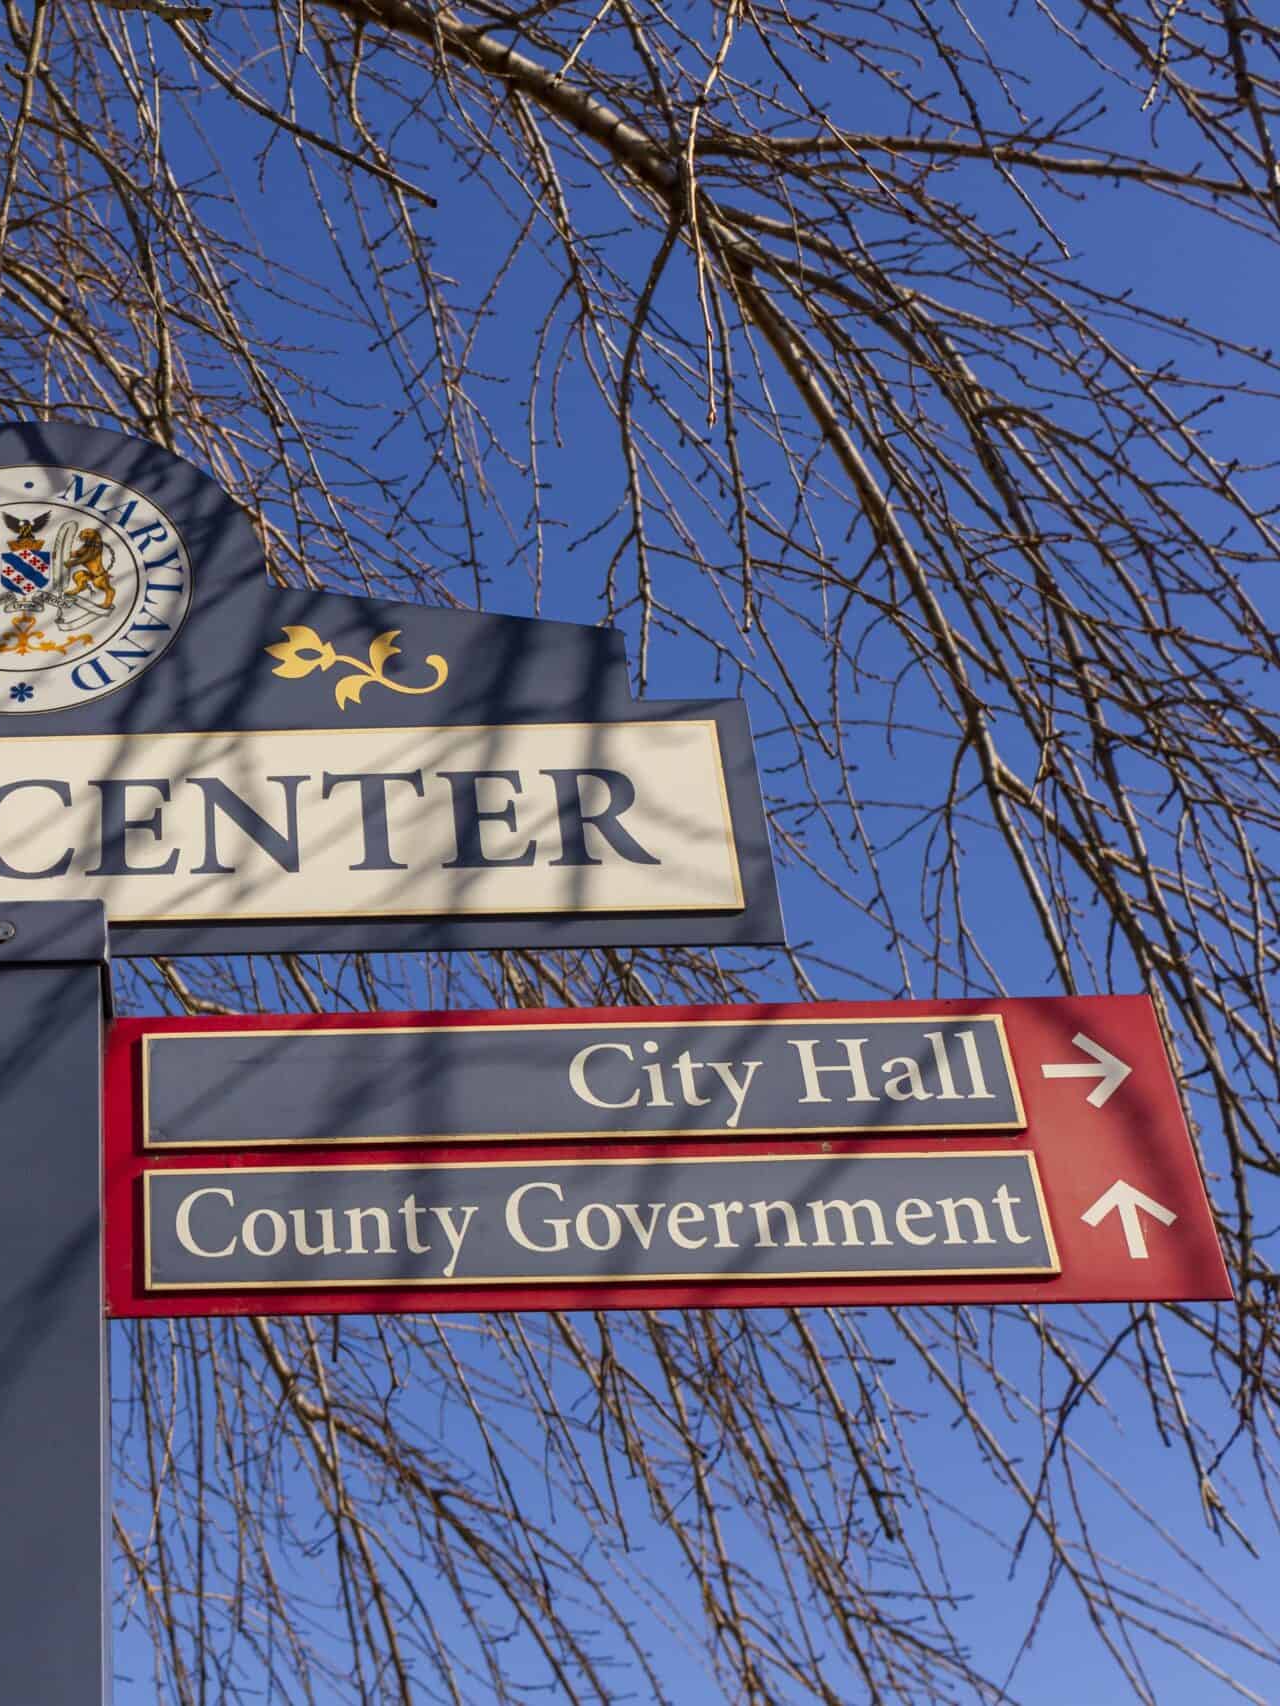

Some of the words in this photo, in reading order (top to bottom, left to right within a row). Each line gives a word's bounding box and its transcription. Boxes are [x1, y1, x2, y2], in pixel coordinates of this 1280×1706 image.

[61, 474, 183, 693] MARYLAND
[569, 1041, 763, 1127] City
[787, 1031, 996, 1105] Hall
[175, 1187, 479, 1278] County
[505, 1182, 1032, 1254] Government
